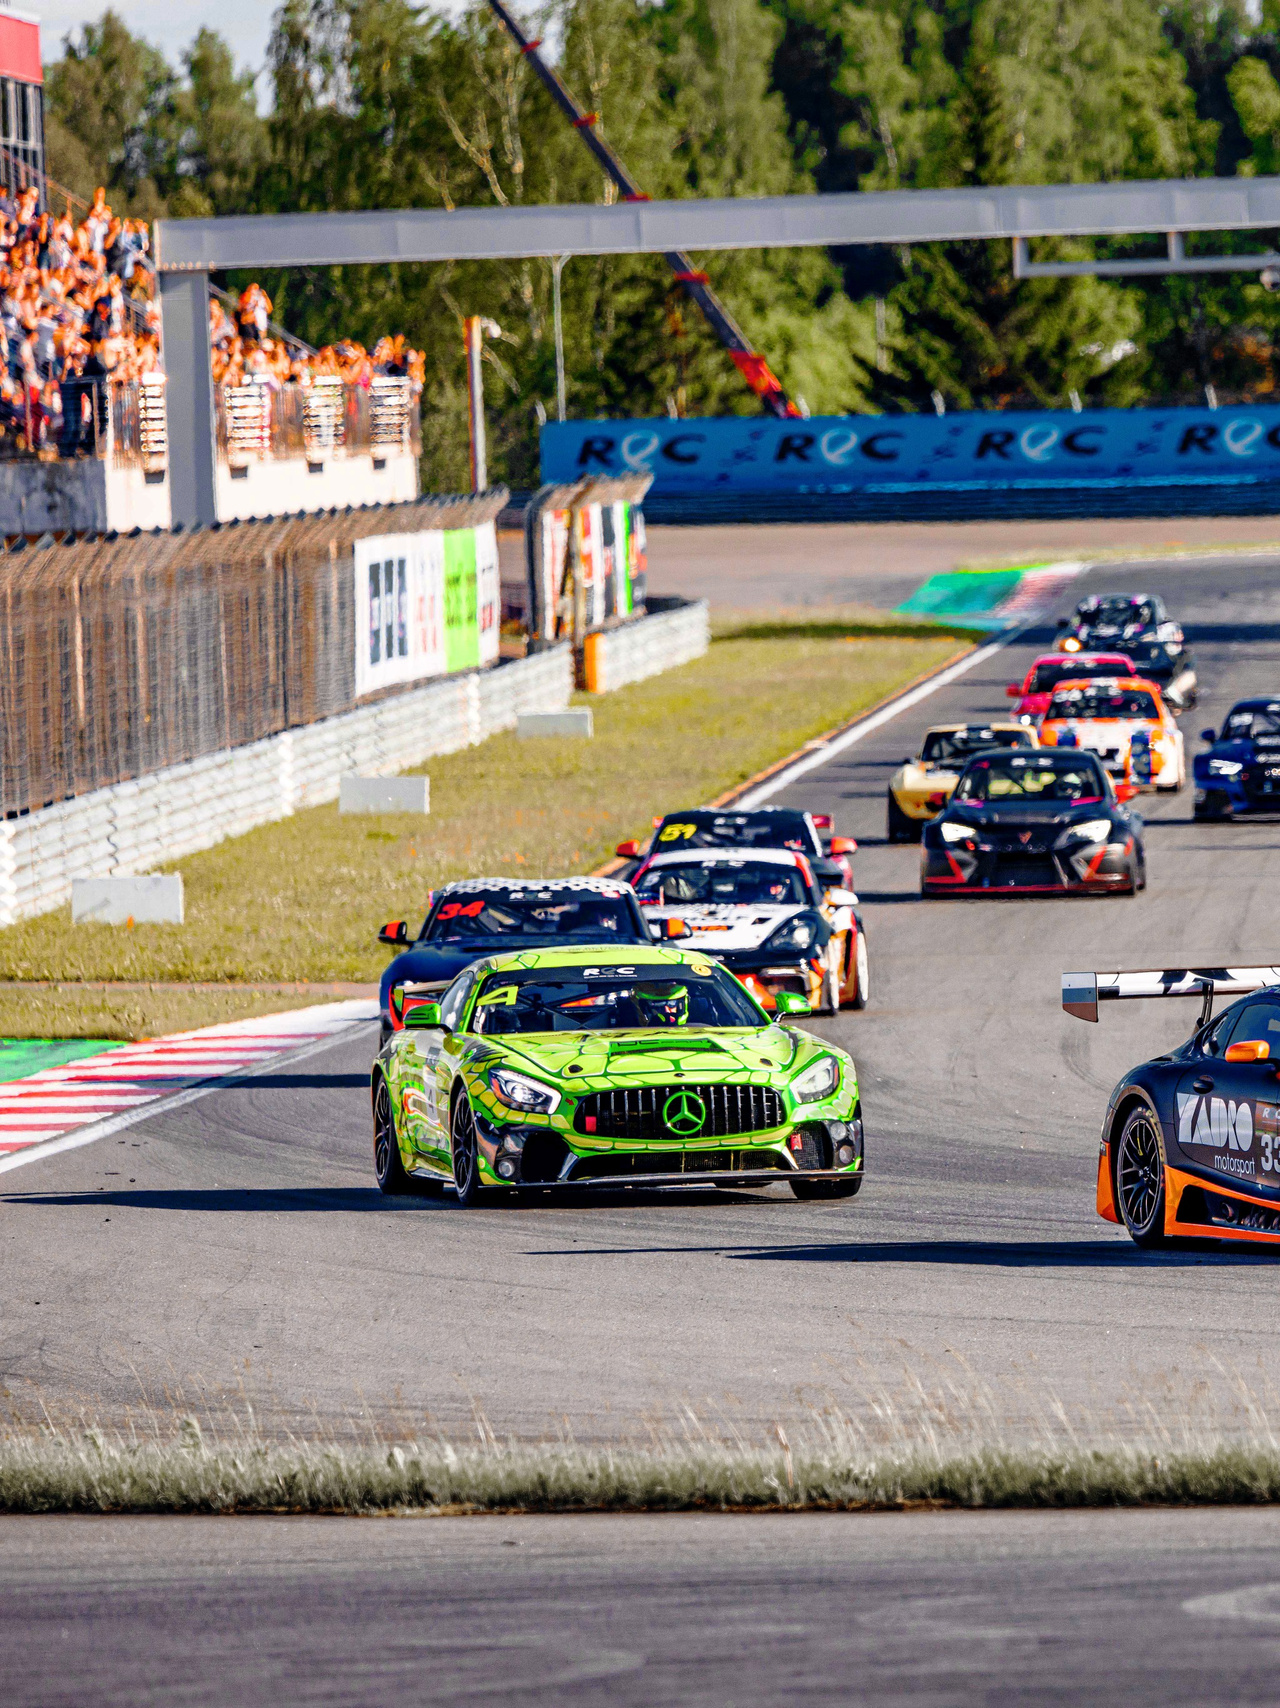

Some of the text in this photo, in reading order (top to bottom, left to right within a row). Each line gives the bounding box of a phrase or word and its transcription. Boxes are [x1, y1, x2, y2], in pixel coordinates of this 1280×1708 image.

[436, 901, 486, 920] 34
[1177, 1093, 1253, 1152] YADRO
[1214, 1153, 1255, 1177] motorsport
